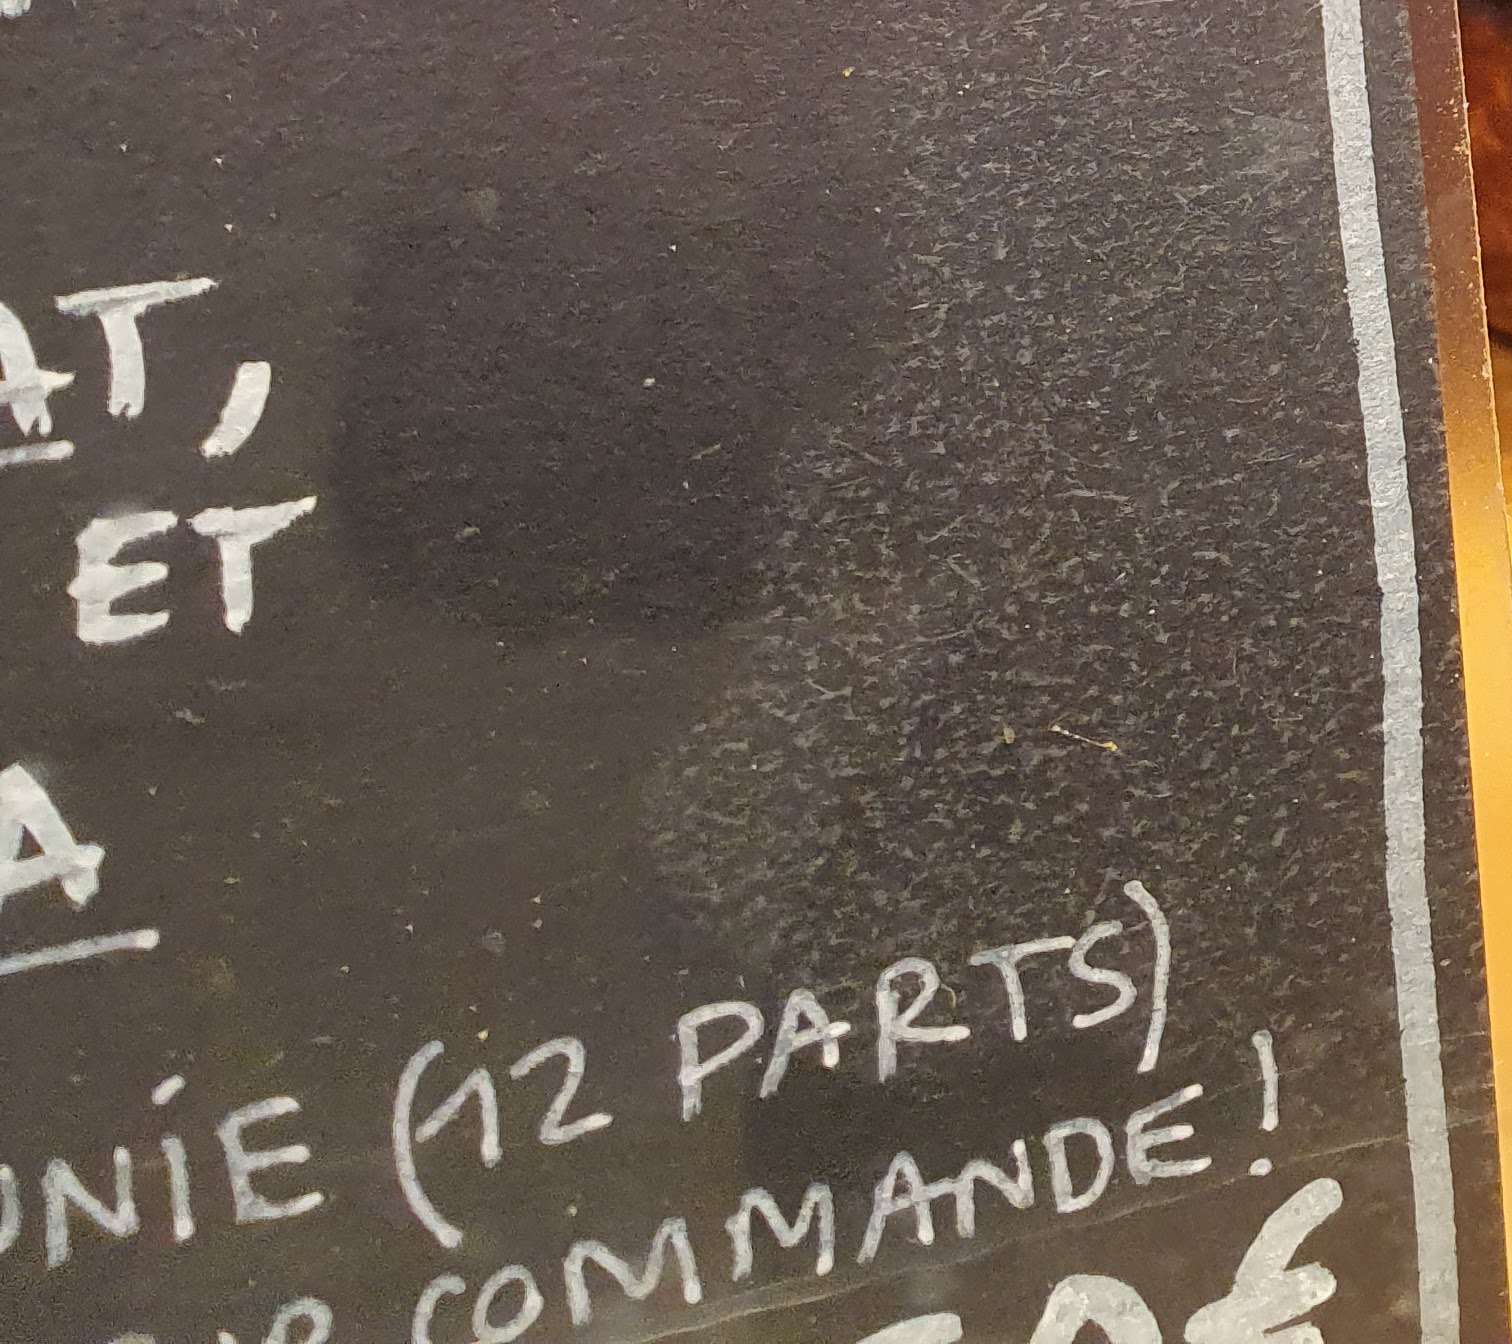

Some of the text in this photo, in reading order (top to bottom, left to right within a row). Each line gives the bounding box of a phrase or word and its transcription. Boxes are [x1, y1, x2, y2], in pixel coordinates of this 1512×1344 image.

[66, 495, 318, 645] ET
[0, 762, 105, 910] A
[675, 879, 1170, 1122] PARTS)
